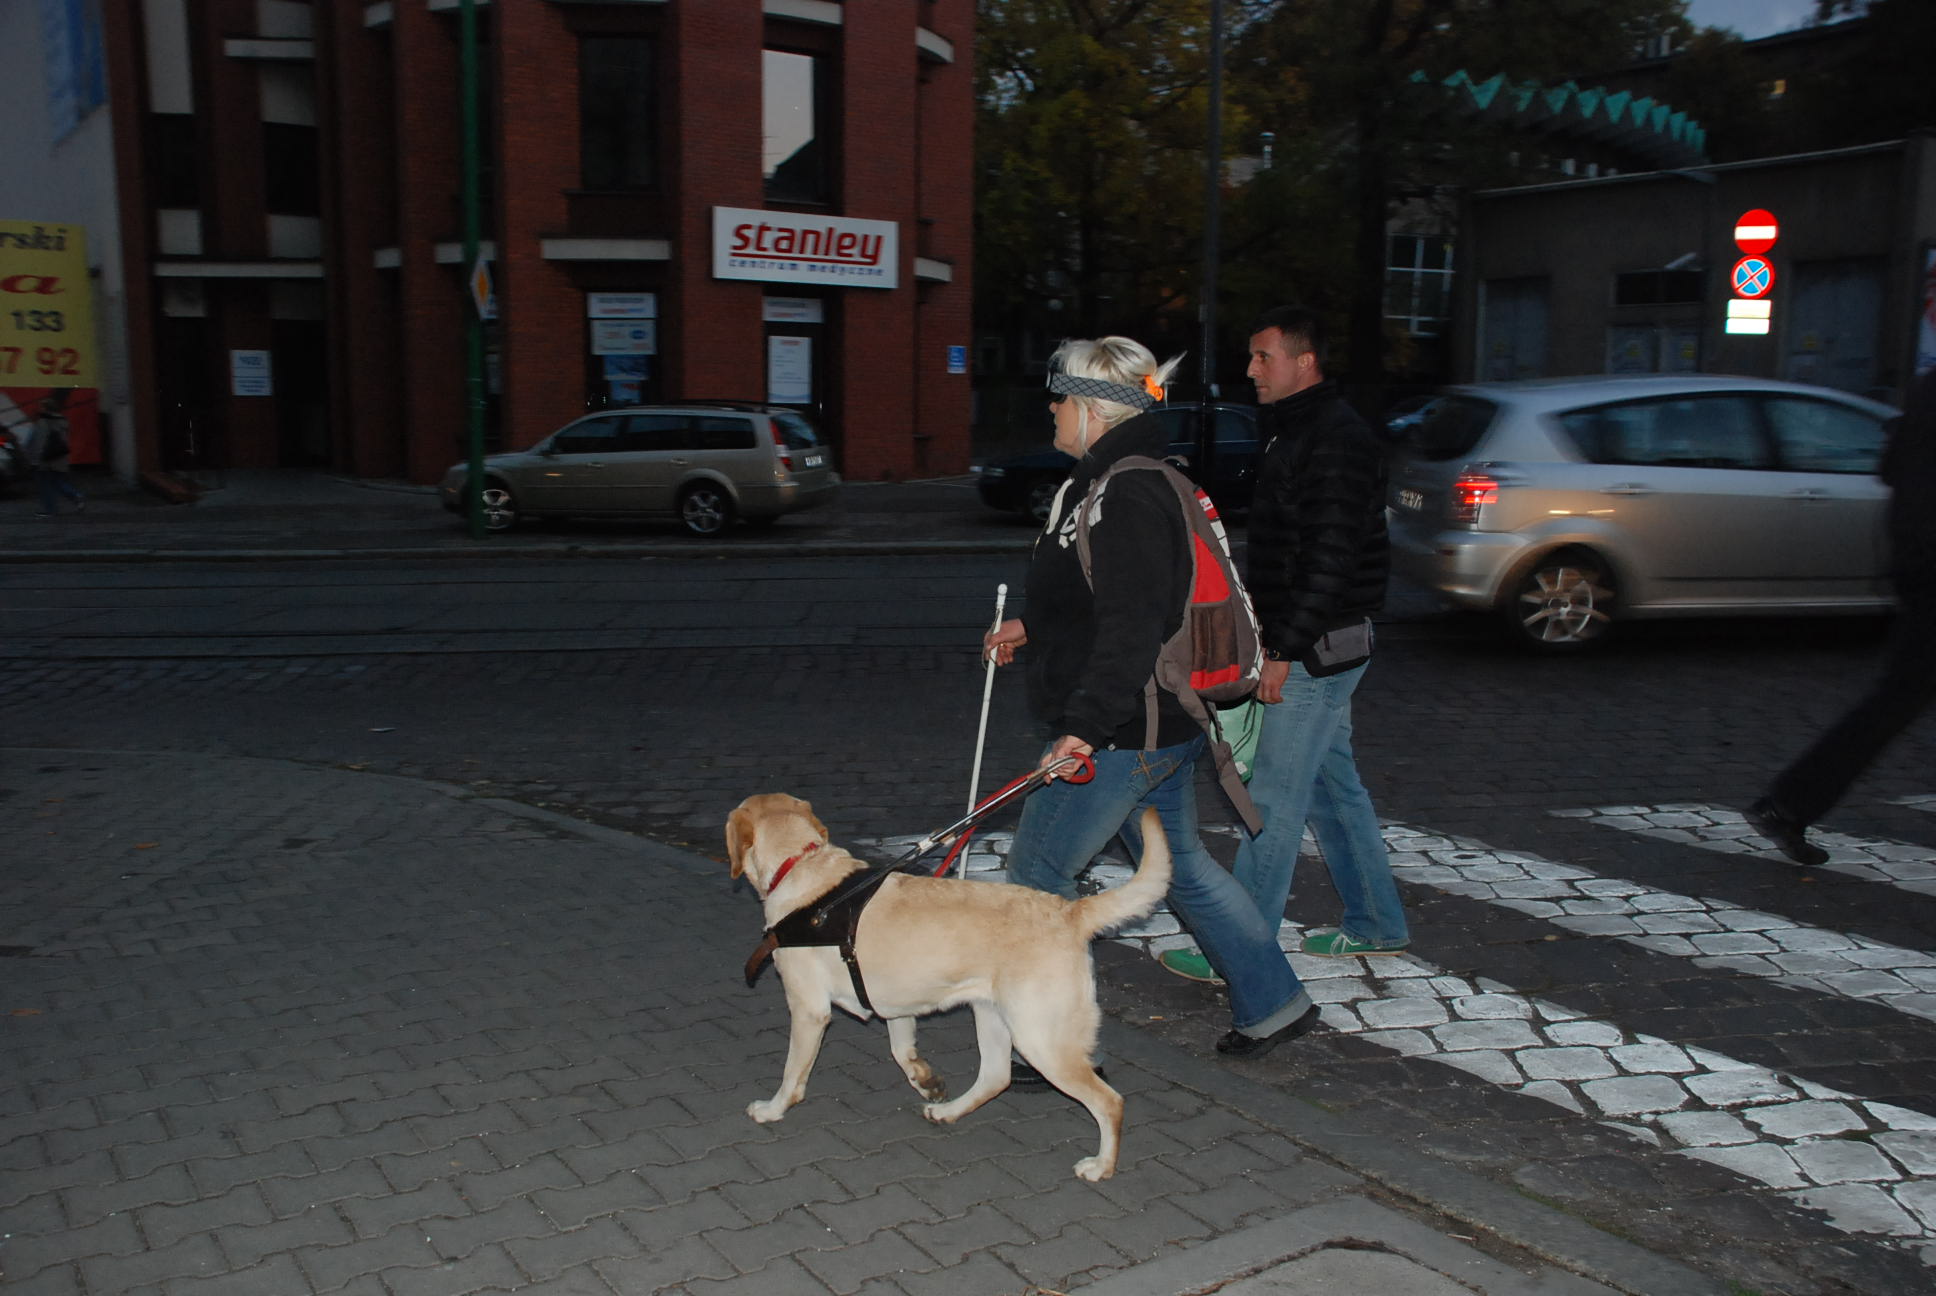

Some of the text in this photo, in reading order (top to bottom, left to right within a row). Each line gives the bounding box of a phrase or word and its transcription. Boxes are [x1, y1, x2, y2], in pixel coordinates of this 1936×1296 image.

[732, 223, 883, 265] stanley
[729, 259, 801, 271] centrum
[11, 309, 65, 332] 133
[36, 347, 81, 376] 92
